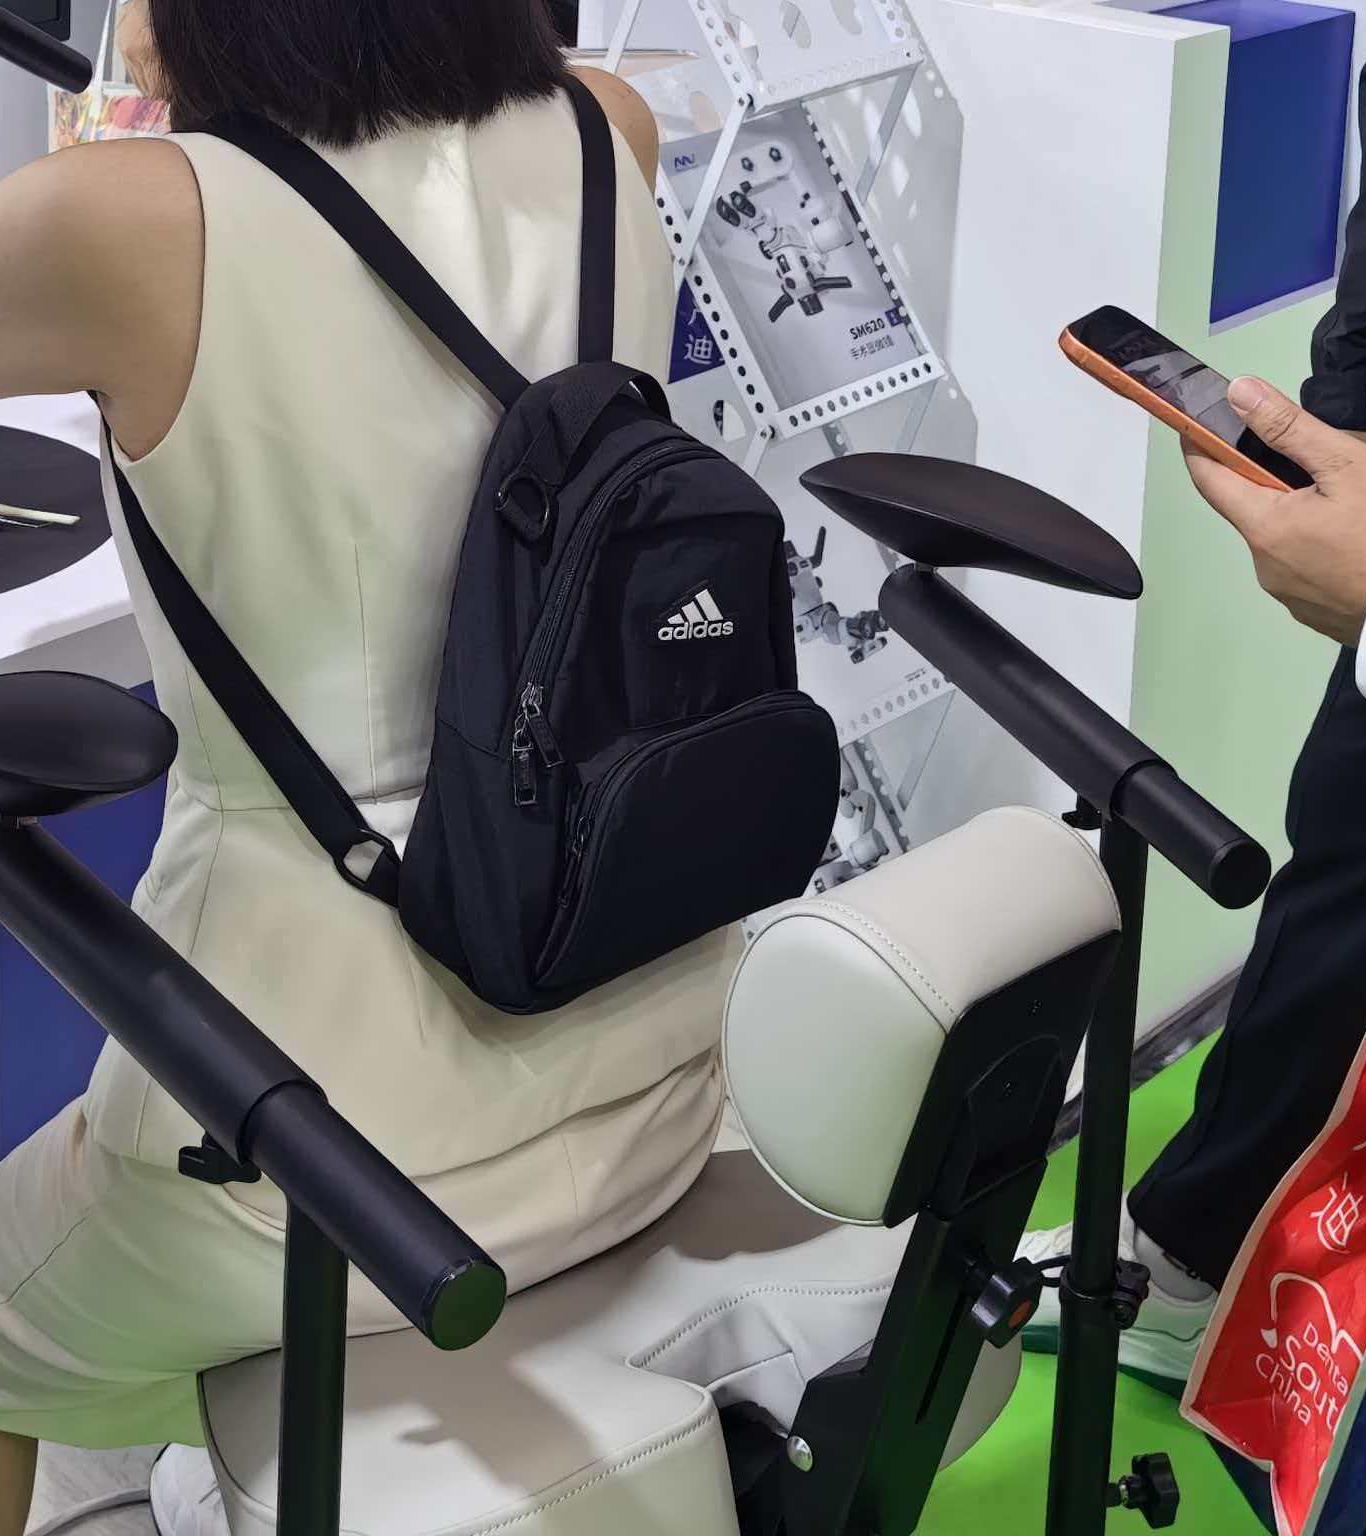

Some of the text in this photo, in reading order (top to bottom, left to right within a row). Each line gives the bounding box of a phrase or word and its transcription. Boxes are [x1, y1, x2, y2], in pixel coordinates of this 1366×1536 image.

[849, 317, 886, 341] SM620
[657, 620, 735, 641] adidas
[1302, 1321, 1349, 1396] Denta
[1255, 1351, 1312, 1426] China
